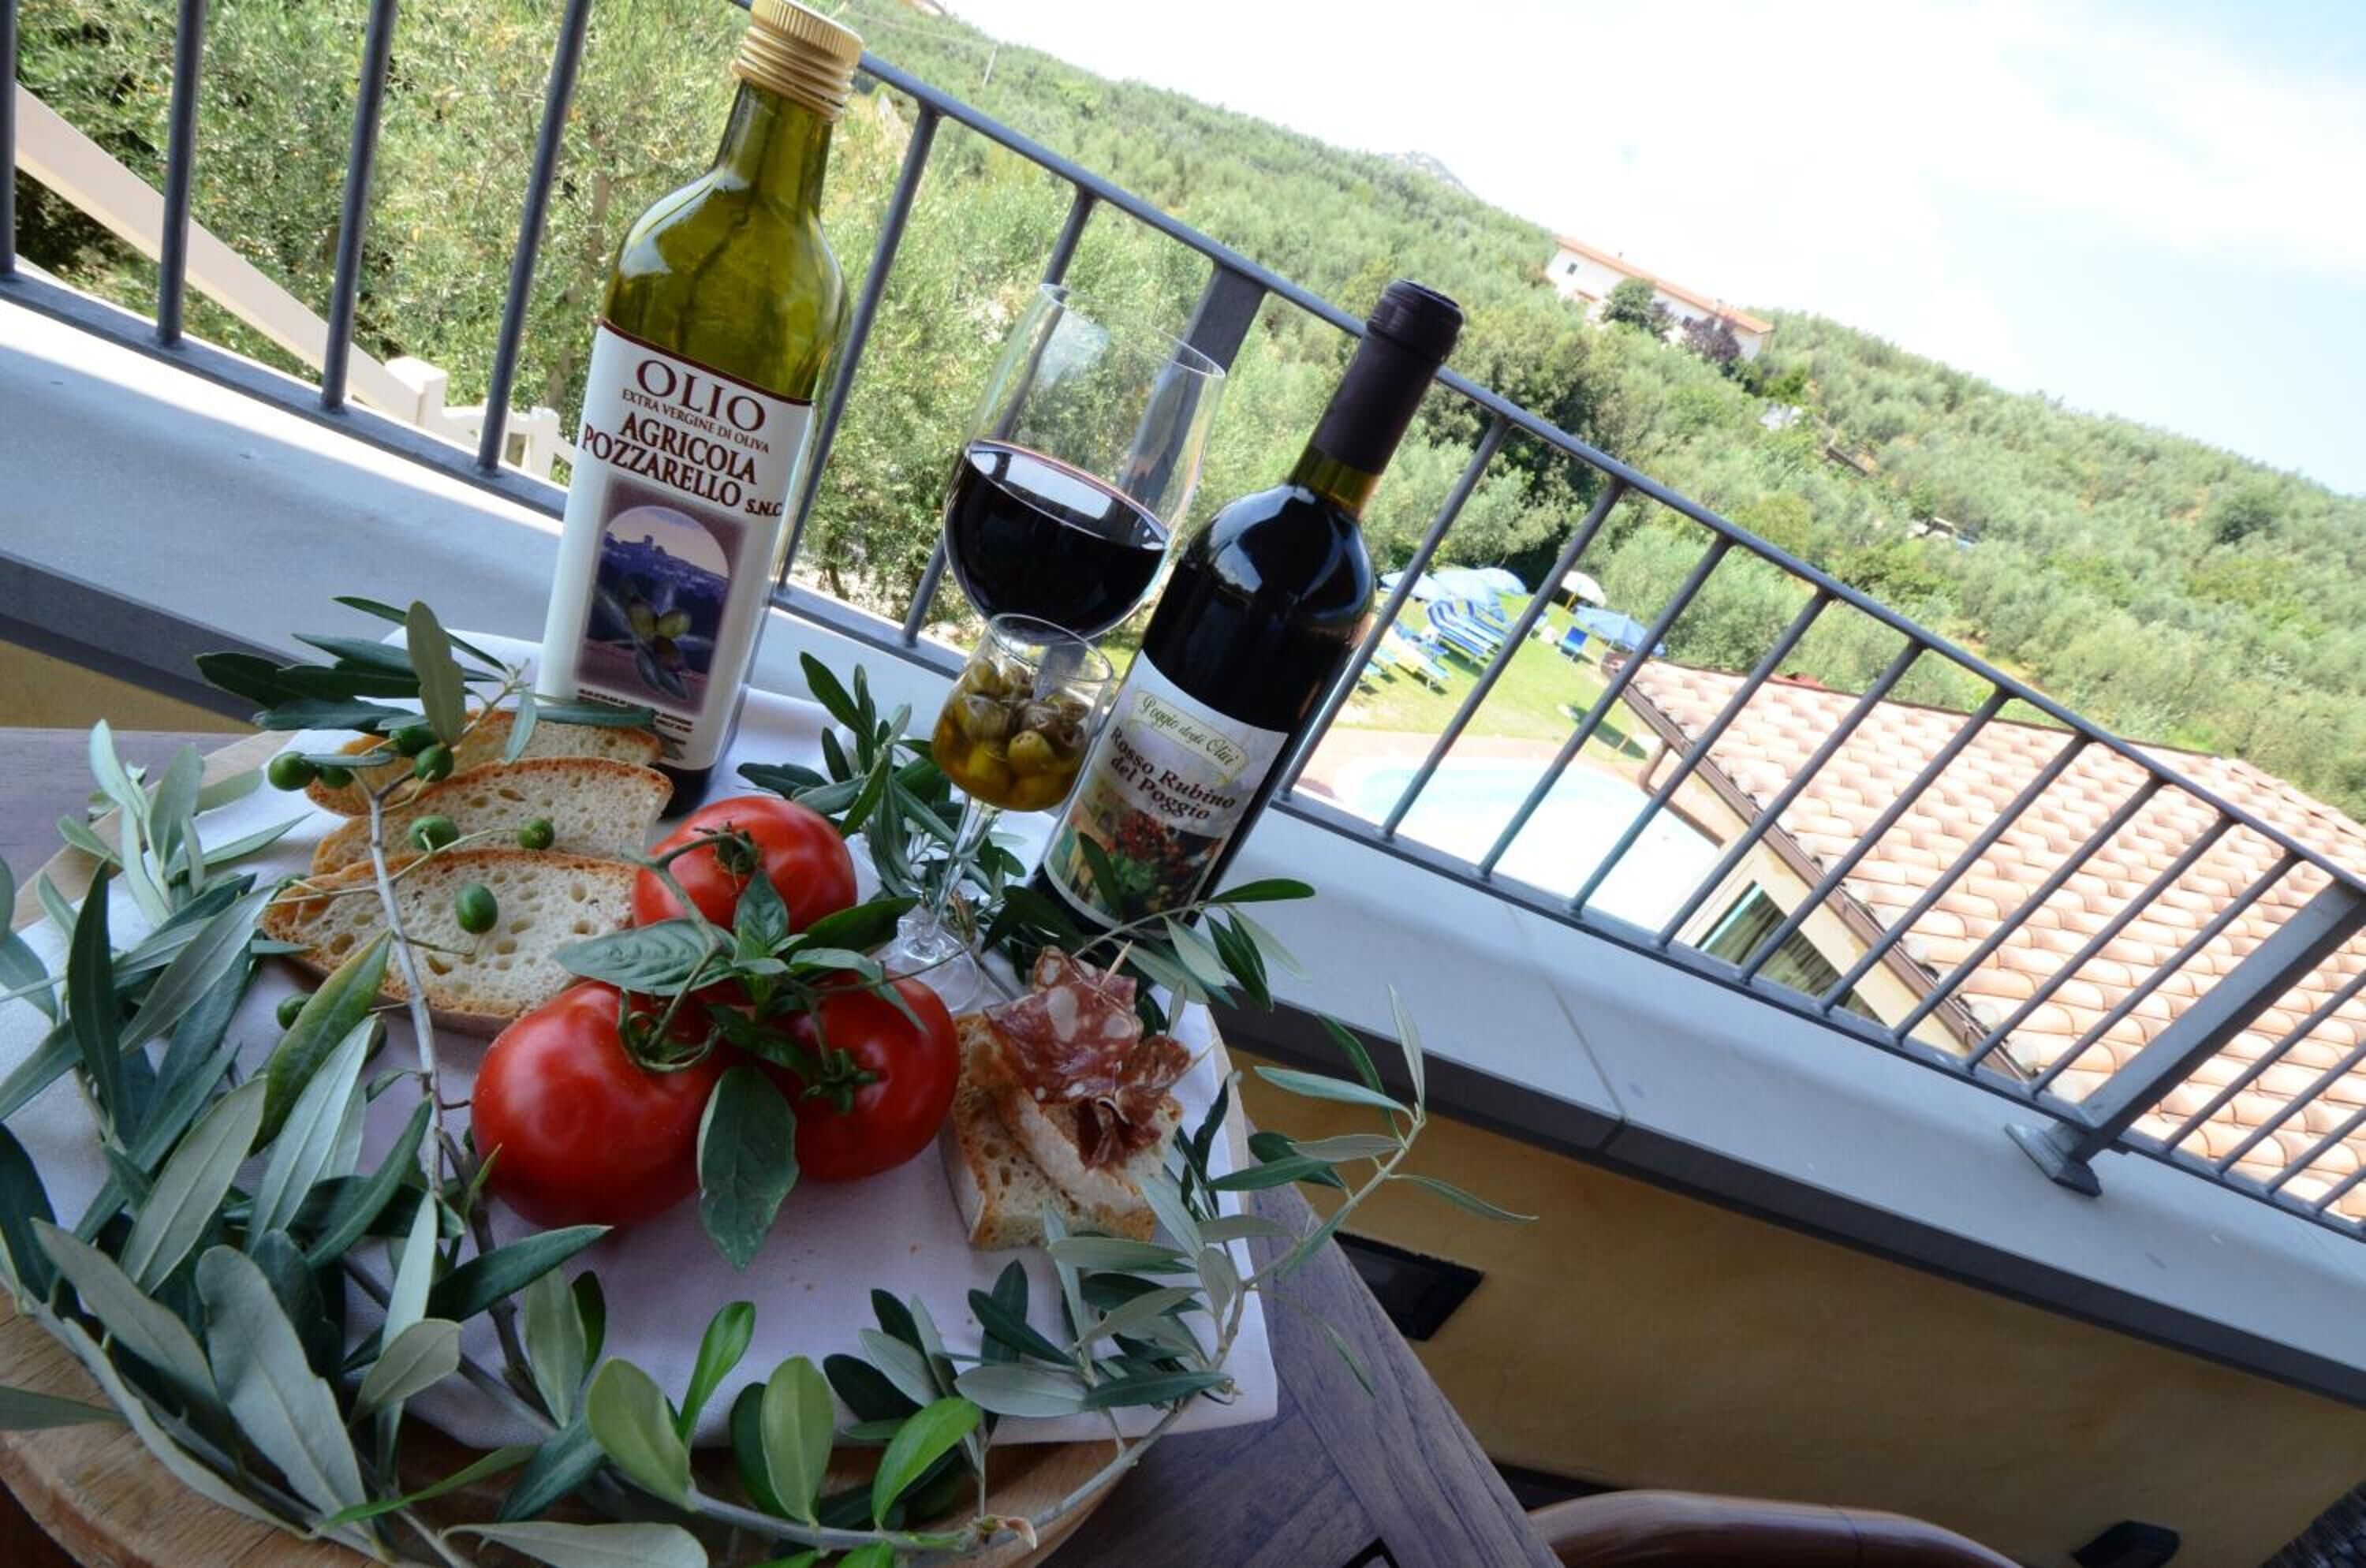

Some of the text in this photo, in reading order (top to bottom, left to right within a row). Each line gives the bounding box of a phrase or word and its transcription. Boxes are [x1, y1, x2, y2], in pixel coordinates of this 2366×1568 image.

[622, 389, 770, 454] EXTRA VERGINE DI OLIVA
[636, 360, 766, 431] OLIO
[582, 424, 741, 507] POZZARELLO
[619, 412, 757, 485] AGRICOLA
[1140, 695, 1179, 730] Poggio
[1110, 726, 1236, 808] Rosso Rubino
[1110, 756, 1211, 819] del Poggio
